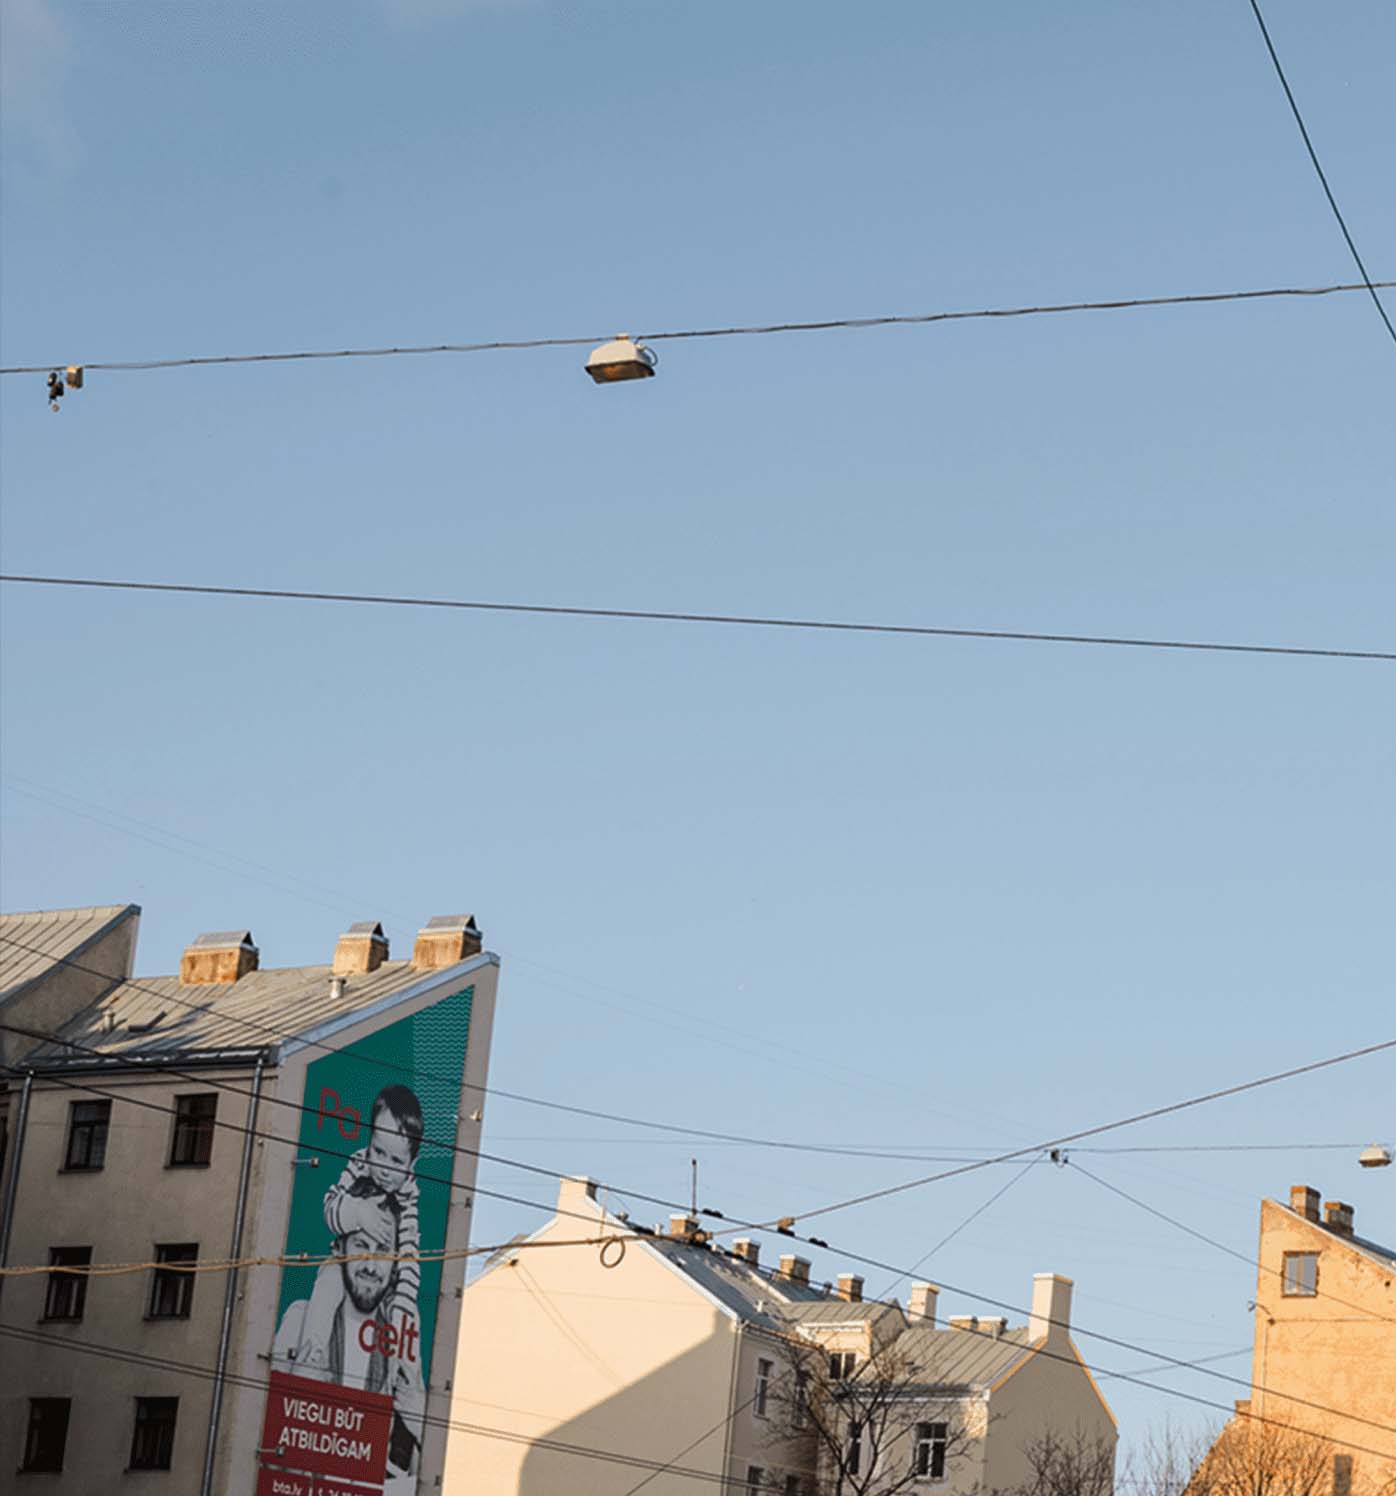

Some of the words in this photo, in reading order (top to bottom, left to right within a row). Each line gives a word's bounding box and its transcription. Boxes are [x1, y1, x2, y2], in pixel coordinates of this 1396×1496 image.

[317, 1087, 360, 1141] Pa
[358, 1312, 419, 1363] celt
[283, 1397, 332, 1426] VIEGLI
[334, 1406, 364, 1433] BŪT
[278, 1426, 372, 1463] ATBILDĪGAM
